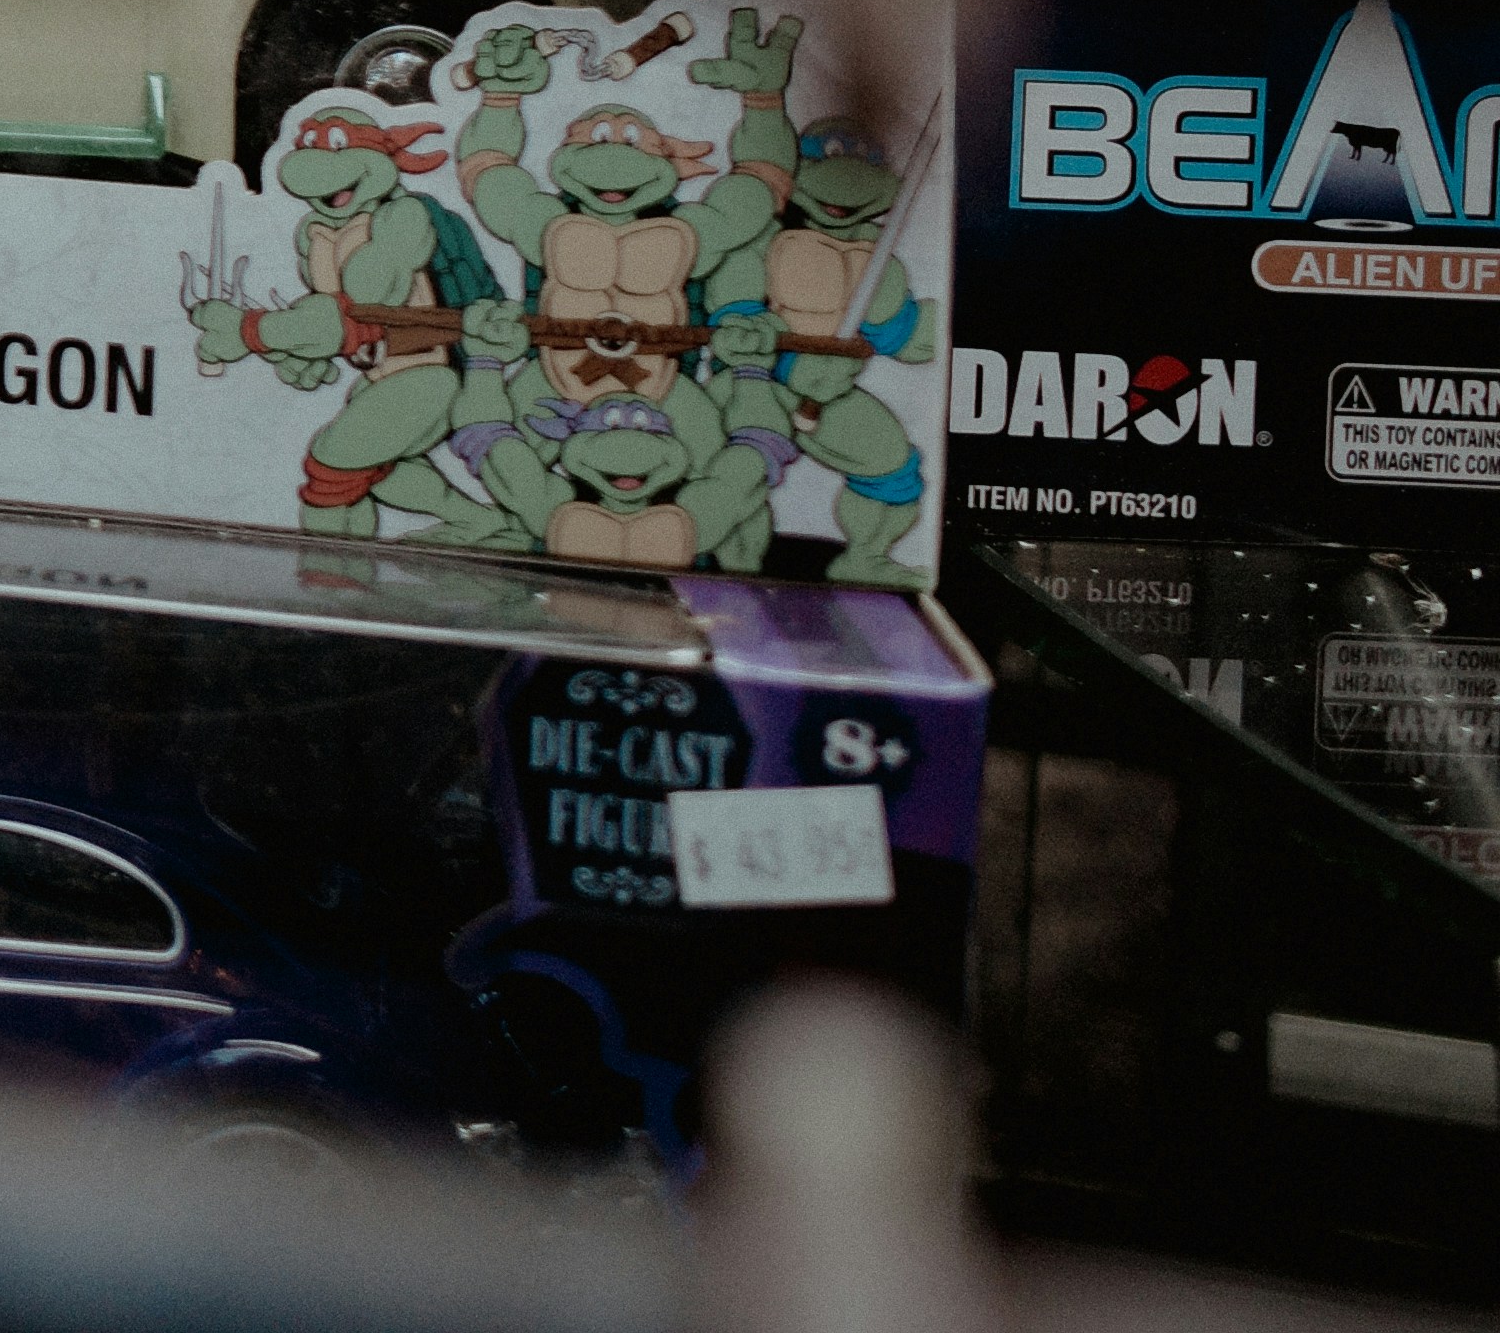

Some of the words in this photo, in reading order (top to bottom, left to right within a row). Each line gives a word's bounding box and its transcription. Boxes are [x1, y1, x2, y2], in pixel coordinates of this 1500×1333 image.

[1291, 251, 1425, 288] ALIEN
[1342, 423, 1380, 444] THIS
[1385, 425, 1417, 446] TOY
[1346, 450, 1369, 470] OR
[1373, 451, 1460, 474] MAGNETIC
[967, 484, 1029, 511] ITEM
[1035, 488, 1081, 514] NO.
[1089, 491, 1197, 519] PT63210
[823, 717, 910, 776] 8+
